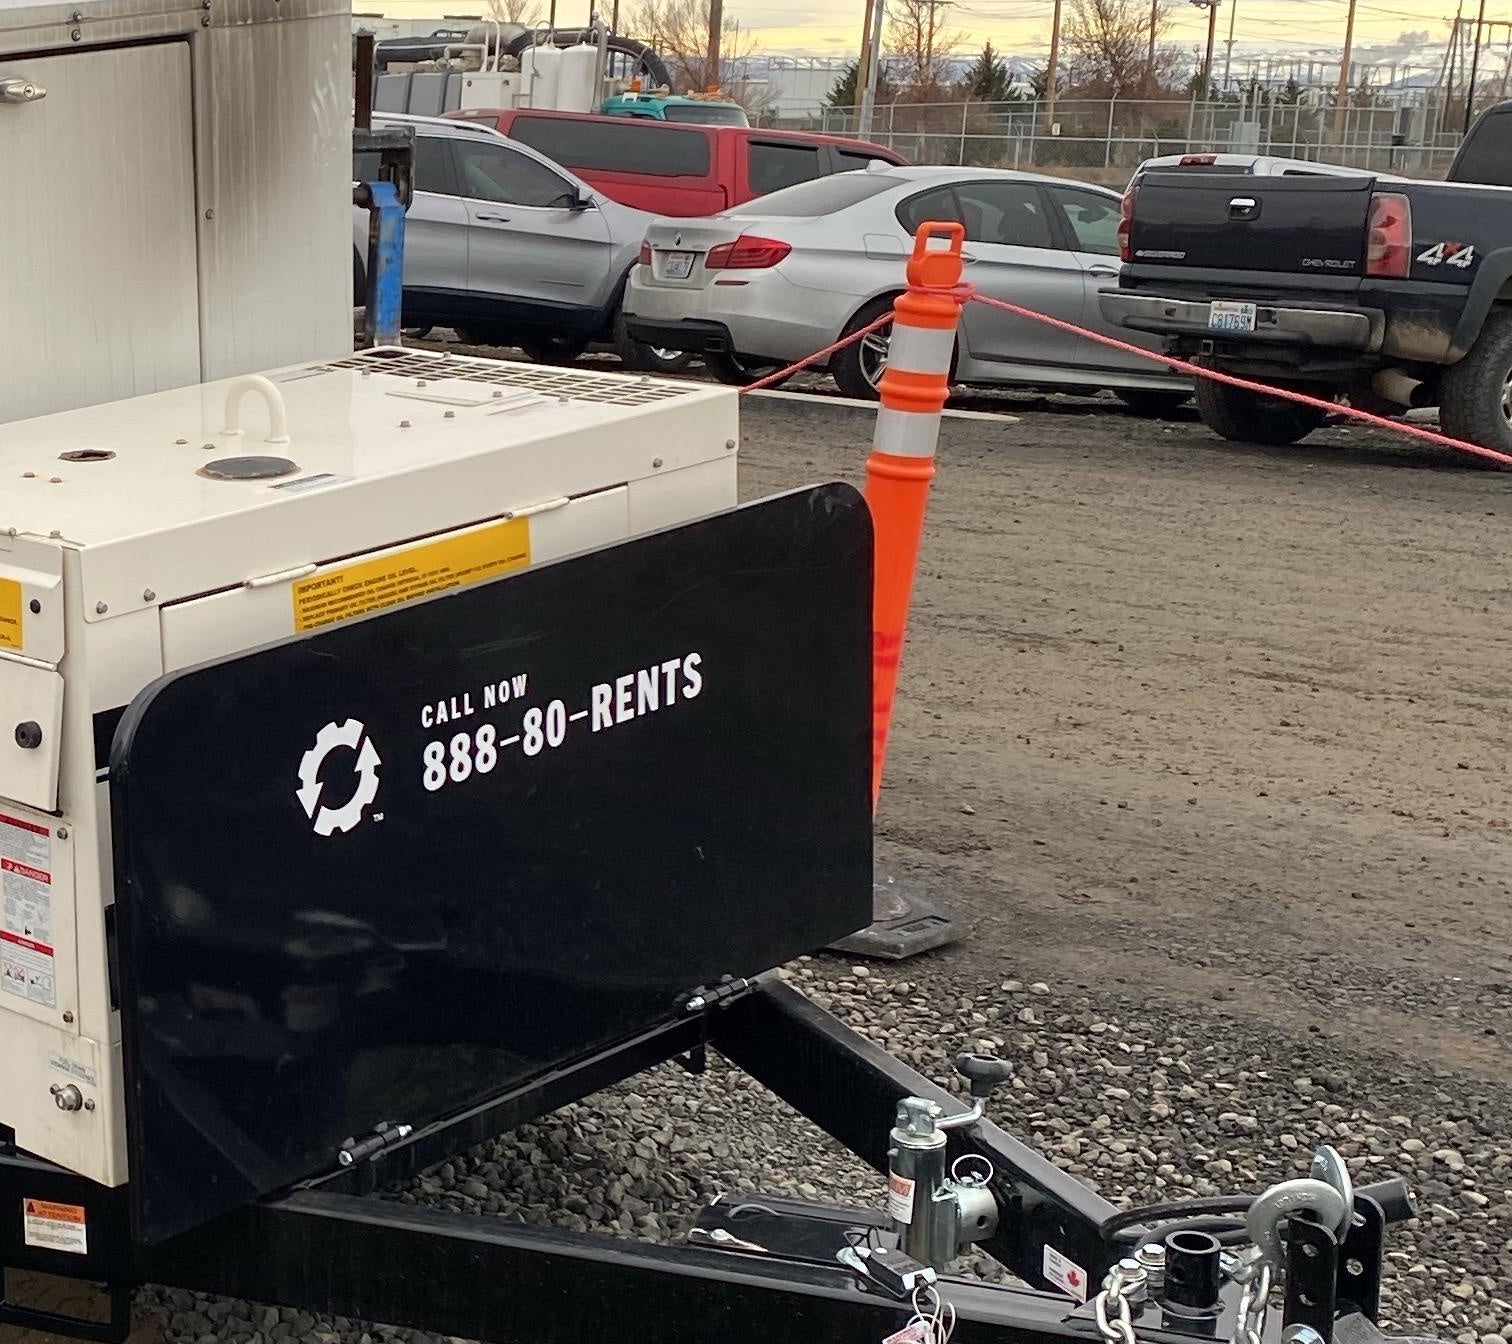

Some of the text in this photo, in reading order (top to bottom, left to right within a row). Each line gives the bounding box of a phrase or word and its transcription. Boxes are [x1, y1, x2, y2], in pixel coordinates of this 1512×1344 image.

[1302, 258, 1357, 269] CHEVROLET
[298, 575, 344, 595] IMPORTANT!
[299, 587, 342, 605] PERIODICALLY
[420, 673, 528, 729] CALL NOW
[422, 652, 703, 792] 888-80-RENTS
